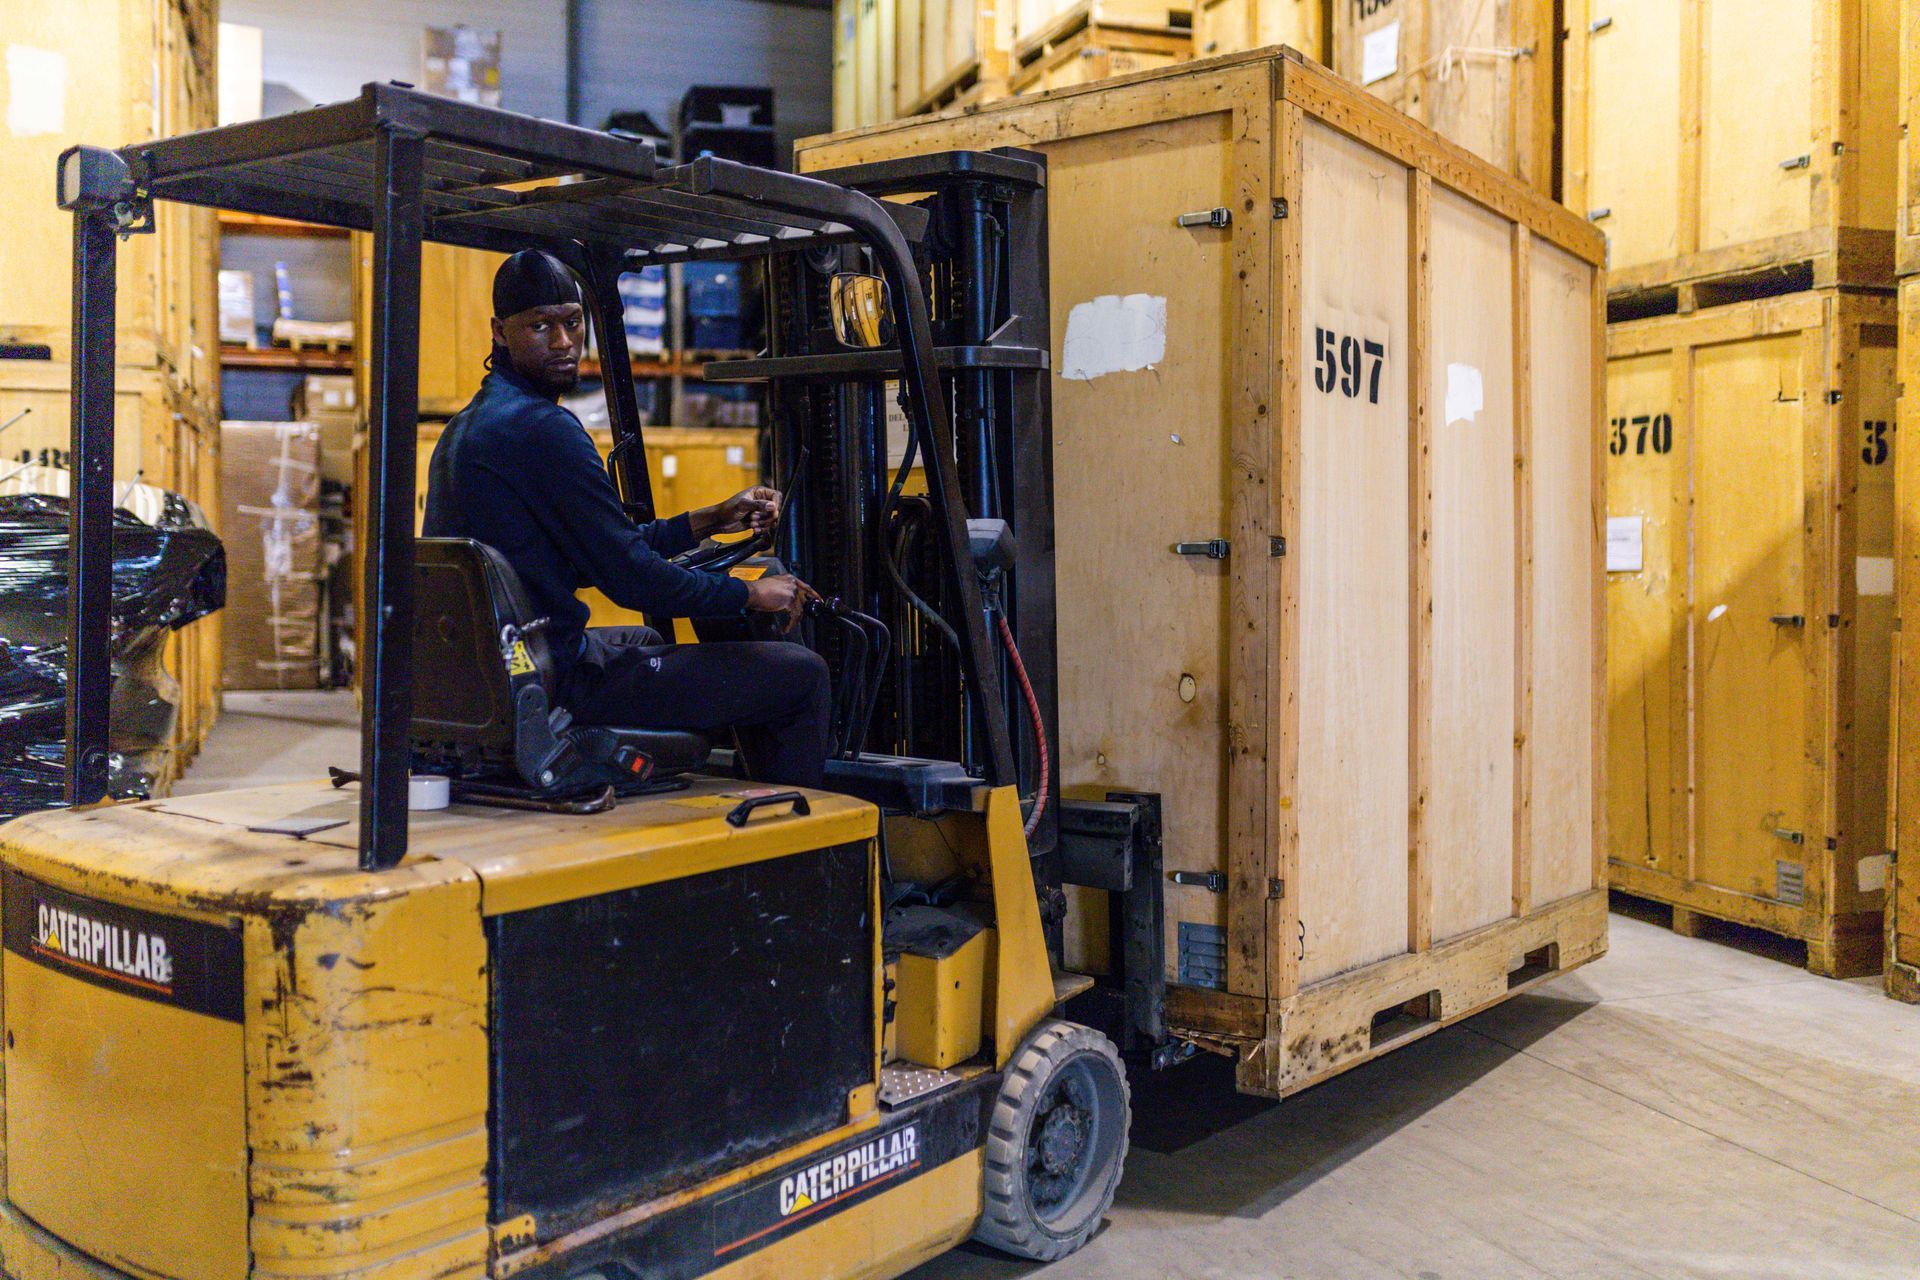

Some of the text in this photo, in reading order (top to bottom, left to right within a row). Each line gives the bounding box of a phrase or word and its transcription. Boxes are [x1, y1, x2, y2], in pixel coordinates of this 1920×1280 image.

[1314, 326, 1384, 405] 597
[1609, 413, 1673, 456] 370
[37, 903, 173, 984] CATERPILLAR
[779, 1125, 917, 1217] CATERPILLAR
